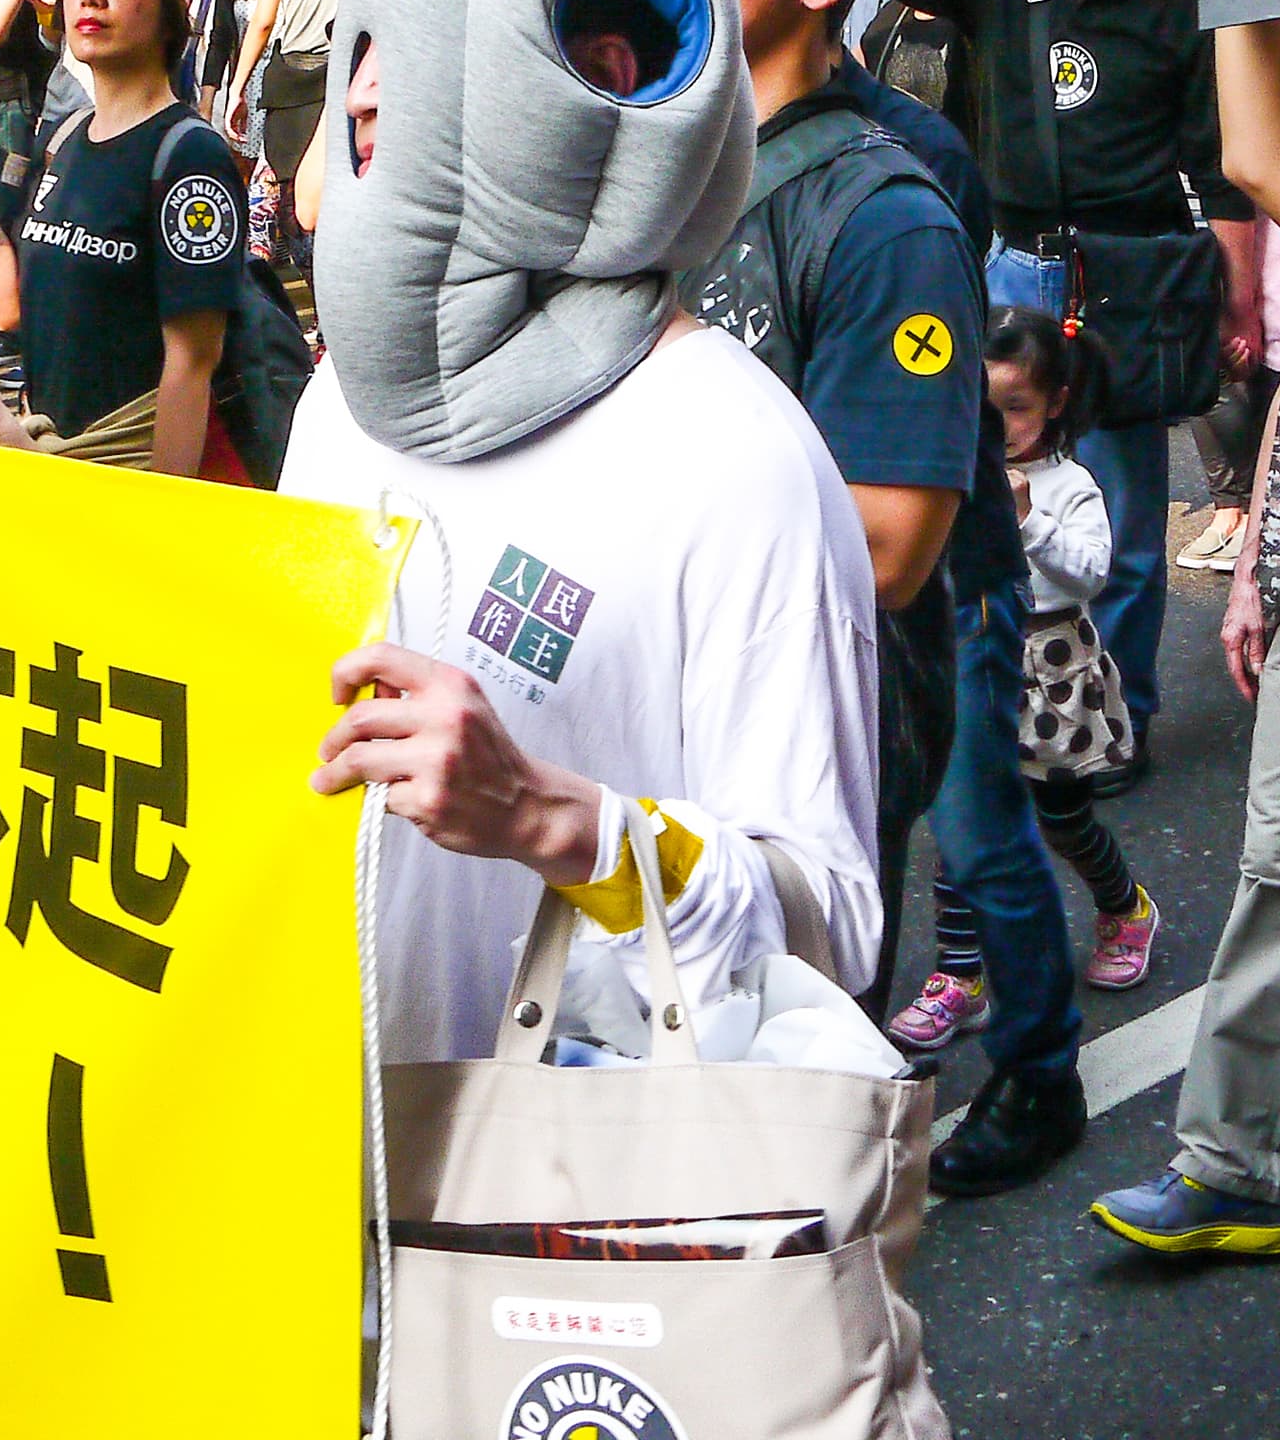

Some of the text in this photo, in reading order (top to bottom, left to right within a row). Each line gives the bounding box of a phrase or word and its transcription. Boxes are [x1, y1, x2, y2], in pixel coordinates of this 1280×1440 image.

[1063, 46, 1092, 73] NUKE
[170, 181, 233, 215] NO NUKE
[67, 224, 137, 264] Дозор
[170, 231, 230, 258] NO FEAR
[541, 1371, 656, 1430] NUKE
